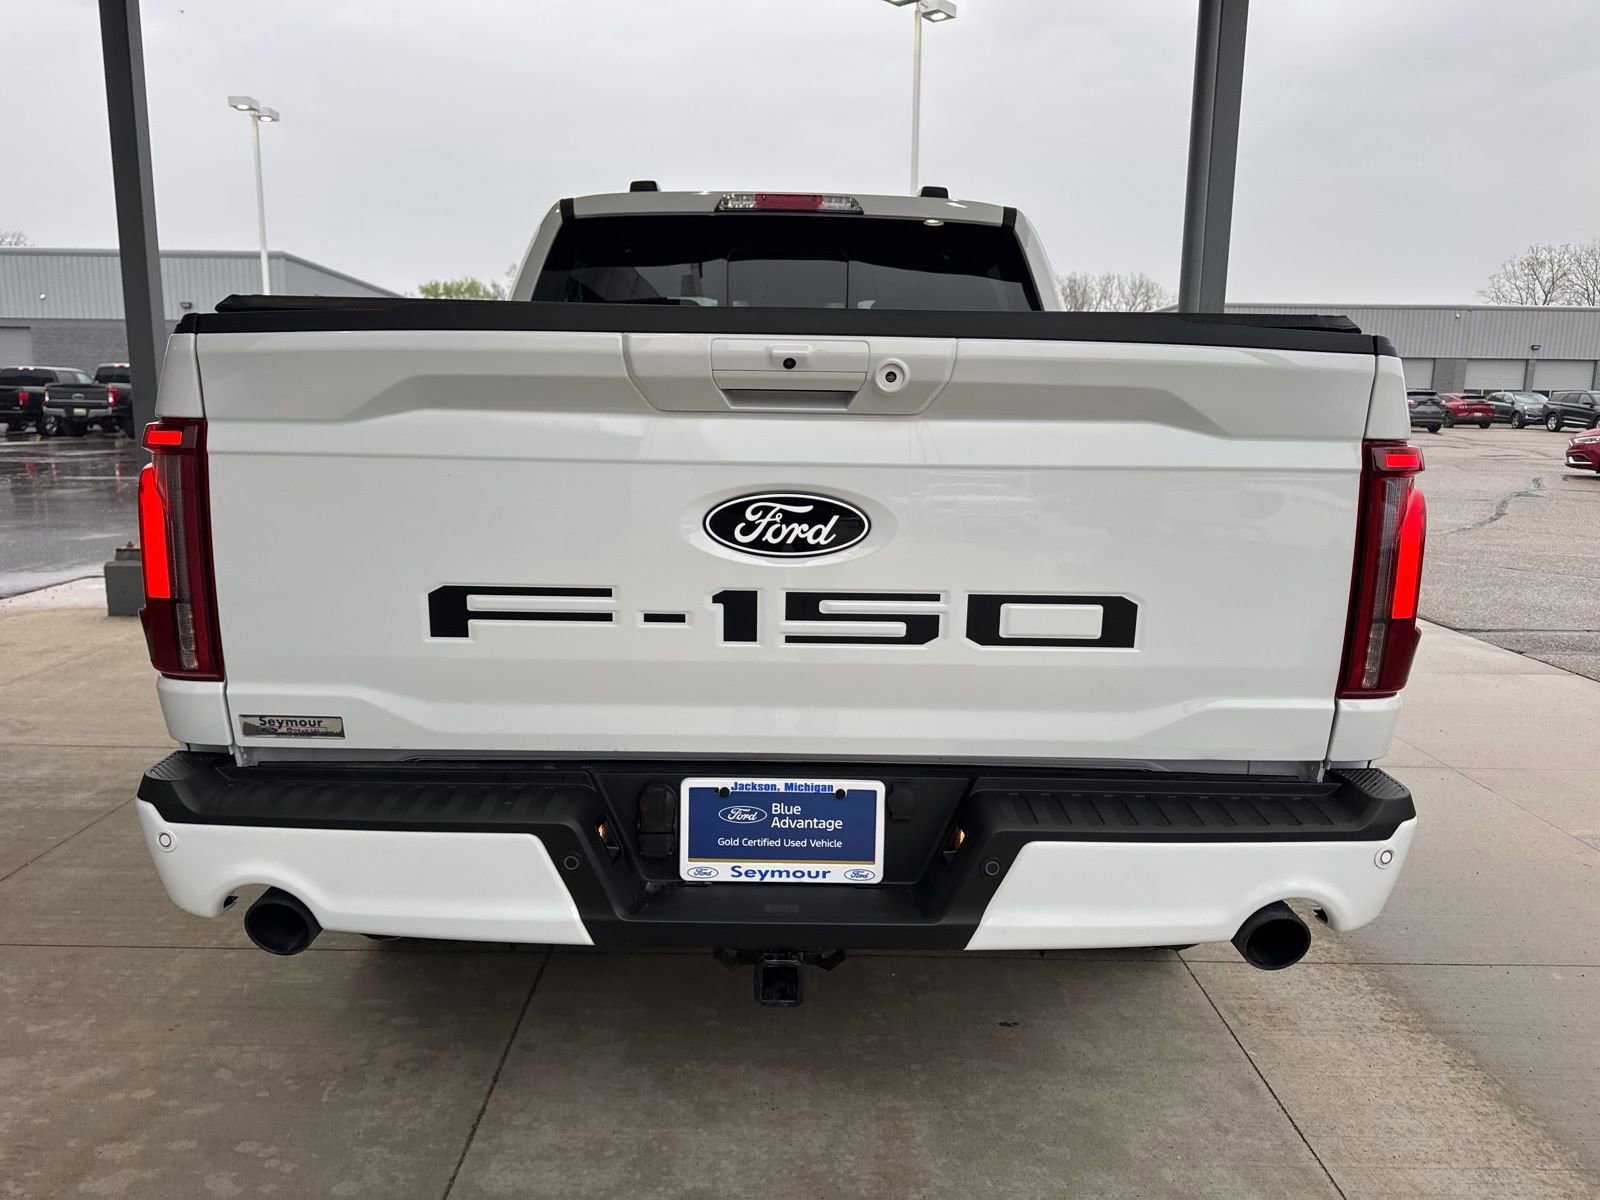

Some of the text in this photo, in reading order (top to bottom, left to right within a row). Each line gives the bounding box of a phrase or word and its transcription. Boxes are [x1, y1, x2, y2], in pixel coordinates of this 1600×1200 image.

[734, 501, 840, 545] Ford
[427, 584, 1140, 649] F-150
[258, 716, 323, 729] Seymour
[784, 782, 833, 793] Michigan
[727, 807, 758, 821] Ford
[771, 803, 801, 815] Blue
[771, 816, 843, 832] Advantage
[717, 837, 843, 848] Gold Certified Used Vehicle
[693, 868, 713, 878] Ford
[730, 865, 831, 881] Seymour
[849, 870, 869, 879] Ford
